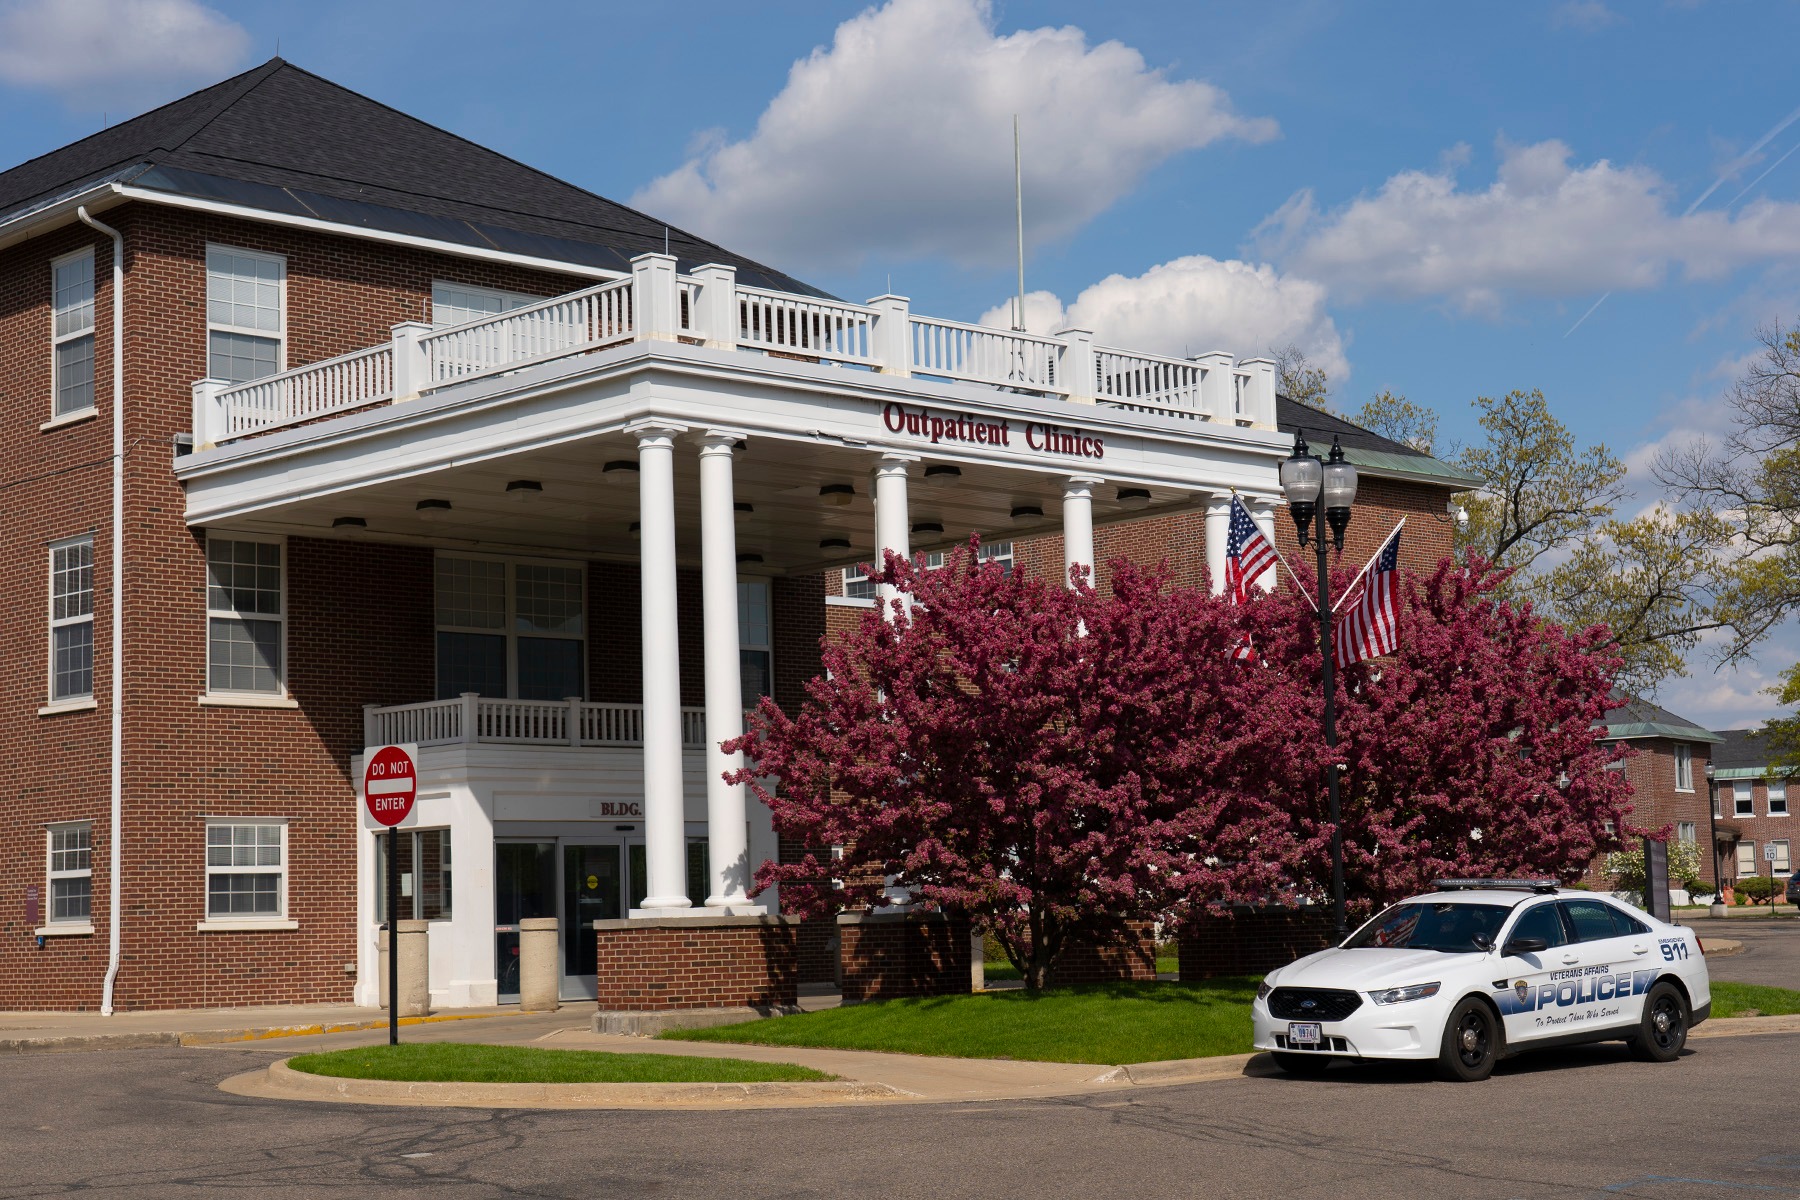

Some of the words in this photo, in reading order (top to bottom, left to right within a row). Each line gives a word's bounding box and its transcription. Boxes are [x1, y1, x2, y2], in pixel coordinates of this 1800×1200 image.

[883, 401, 1010, 446] Outpatient
[1025, 421, 1104, 459] Clinics
[372, 763, 385, 776] DO
[390, 761, 409, 774] NOT
[375, 797, 405, 811] ENTER
[600, 802, 642, 816] BLDG.
[1660, 943, 1688, 961] 911
[1550, 969, 1583, 981] VETERANS
[1583, 965, 1609, 976] AFFAIRS
[1537, 972, 1632, 1010] POLICE
[1535, 1017, 1544, 1027] To
[1546, 1015, 1567, 1026] Protect
[1568, 1012, 1585, 1022] Those
[1586, 1010, 1599, 1020] Who
[1601, 1007, 1620, 1017] Served
